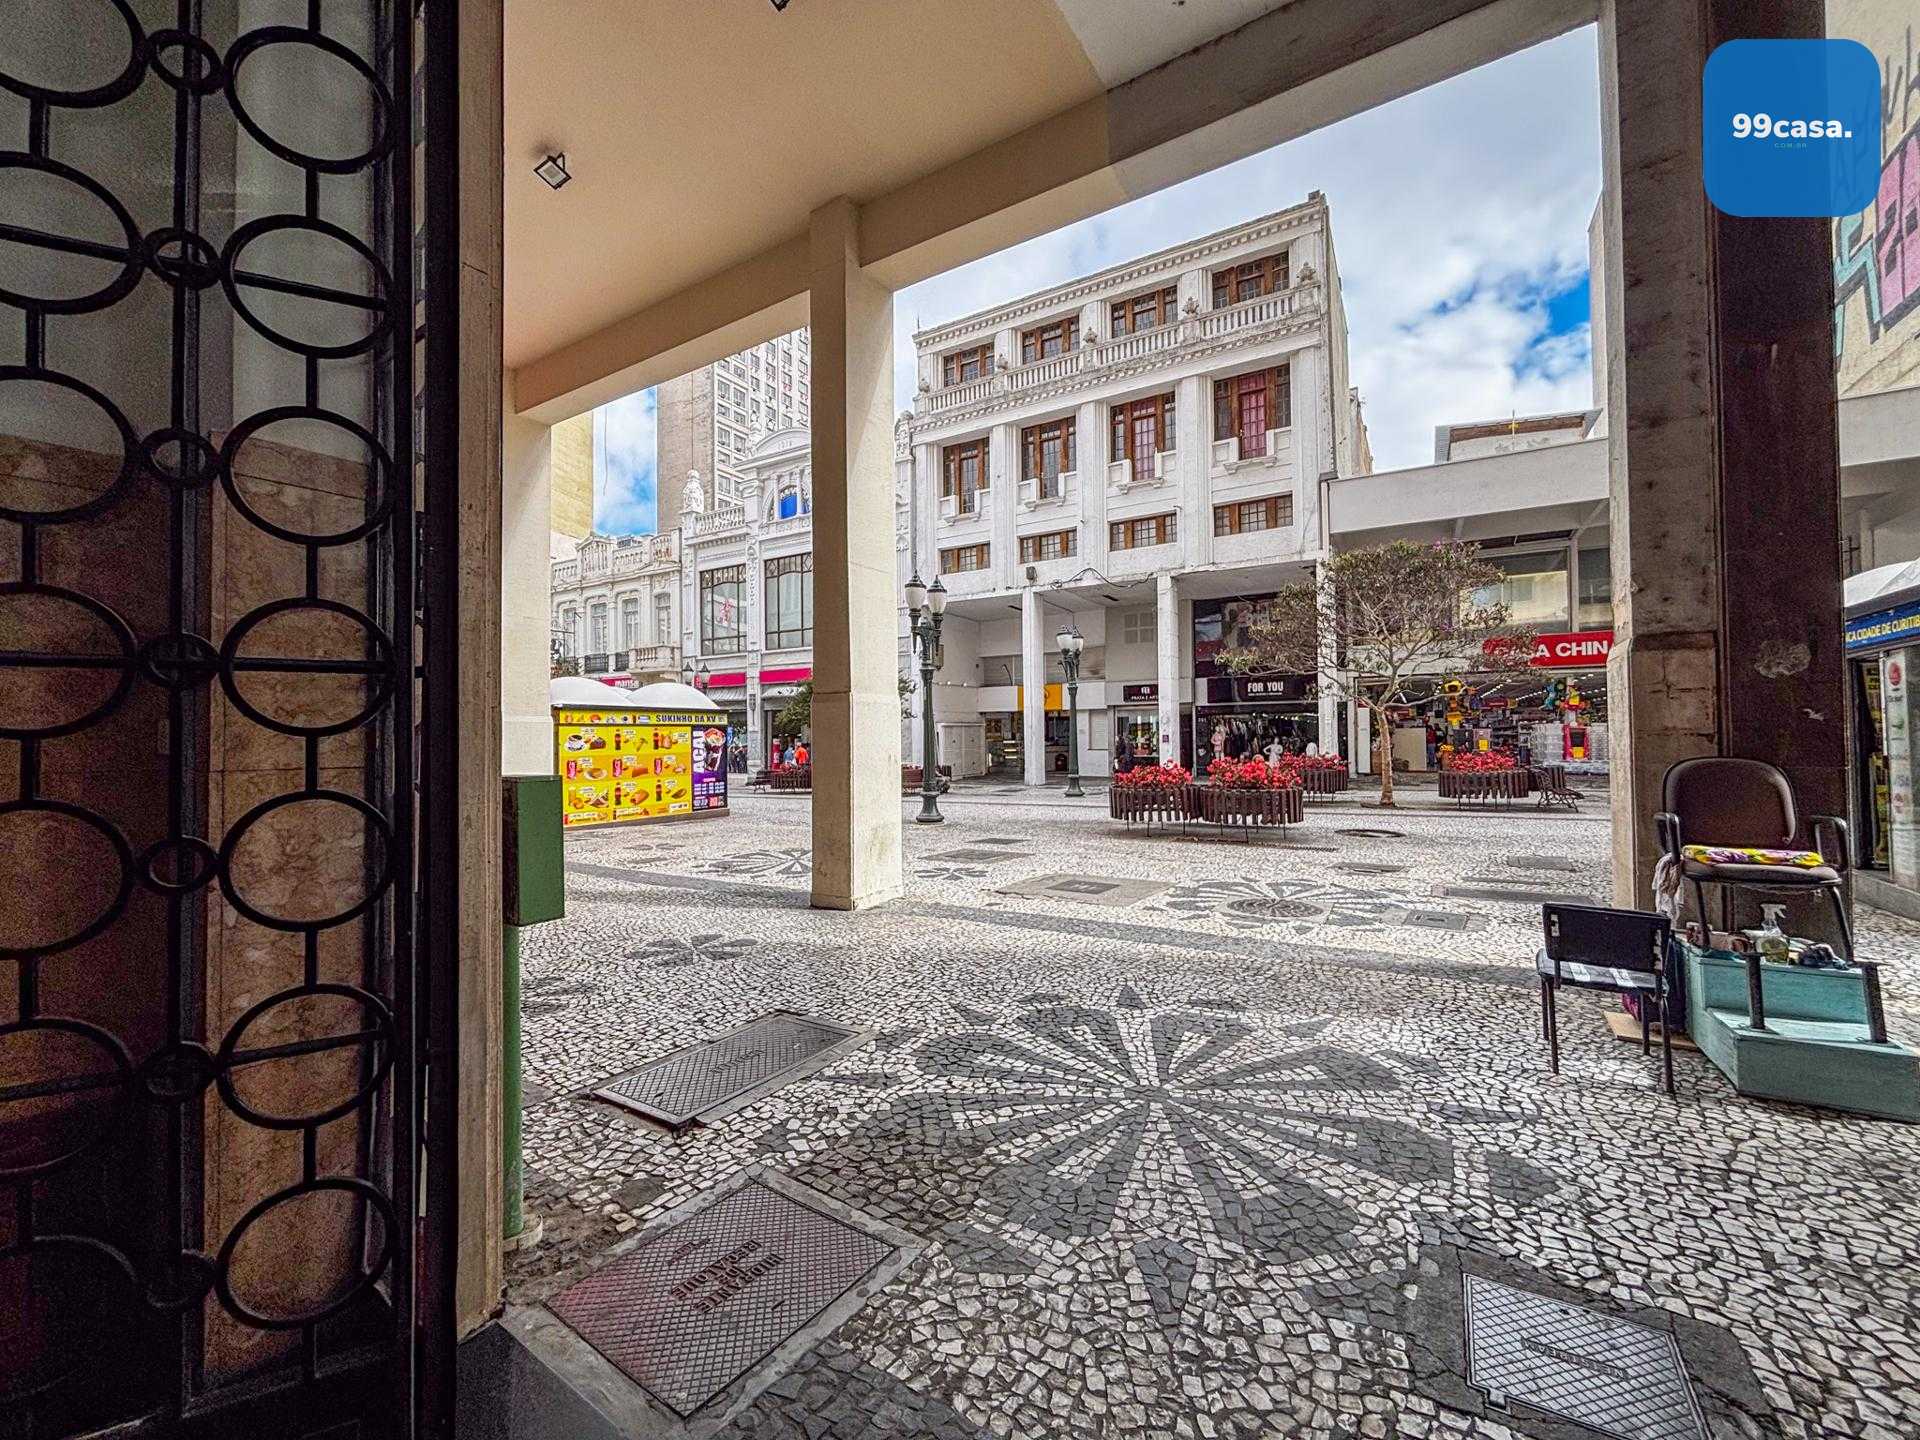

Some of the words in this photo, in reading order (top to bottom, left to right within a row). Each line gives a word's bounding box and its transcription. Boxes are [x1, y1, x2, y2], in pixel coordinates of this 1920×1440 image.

[1555, 640, 1609, 657] CHIN
[1247, 682, 1264, 692] FOR
[1267, 681, 1284, 691] YOU
